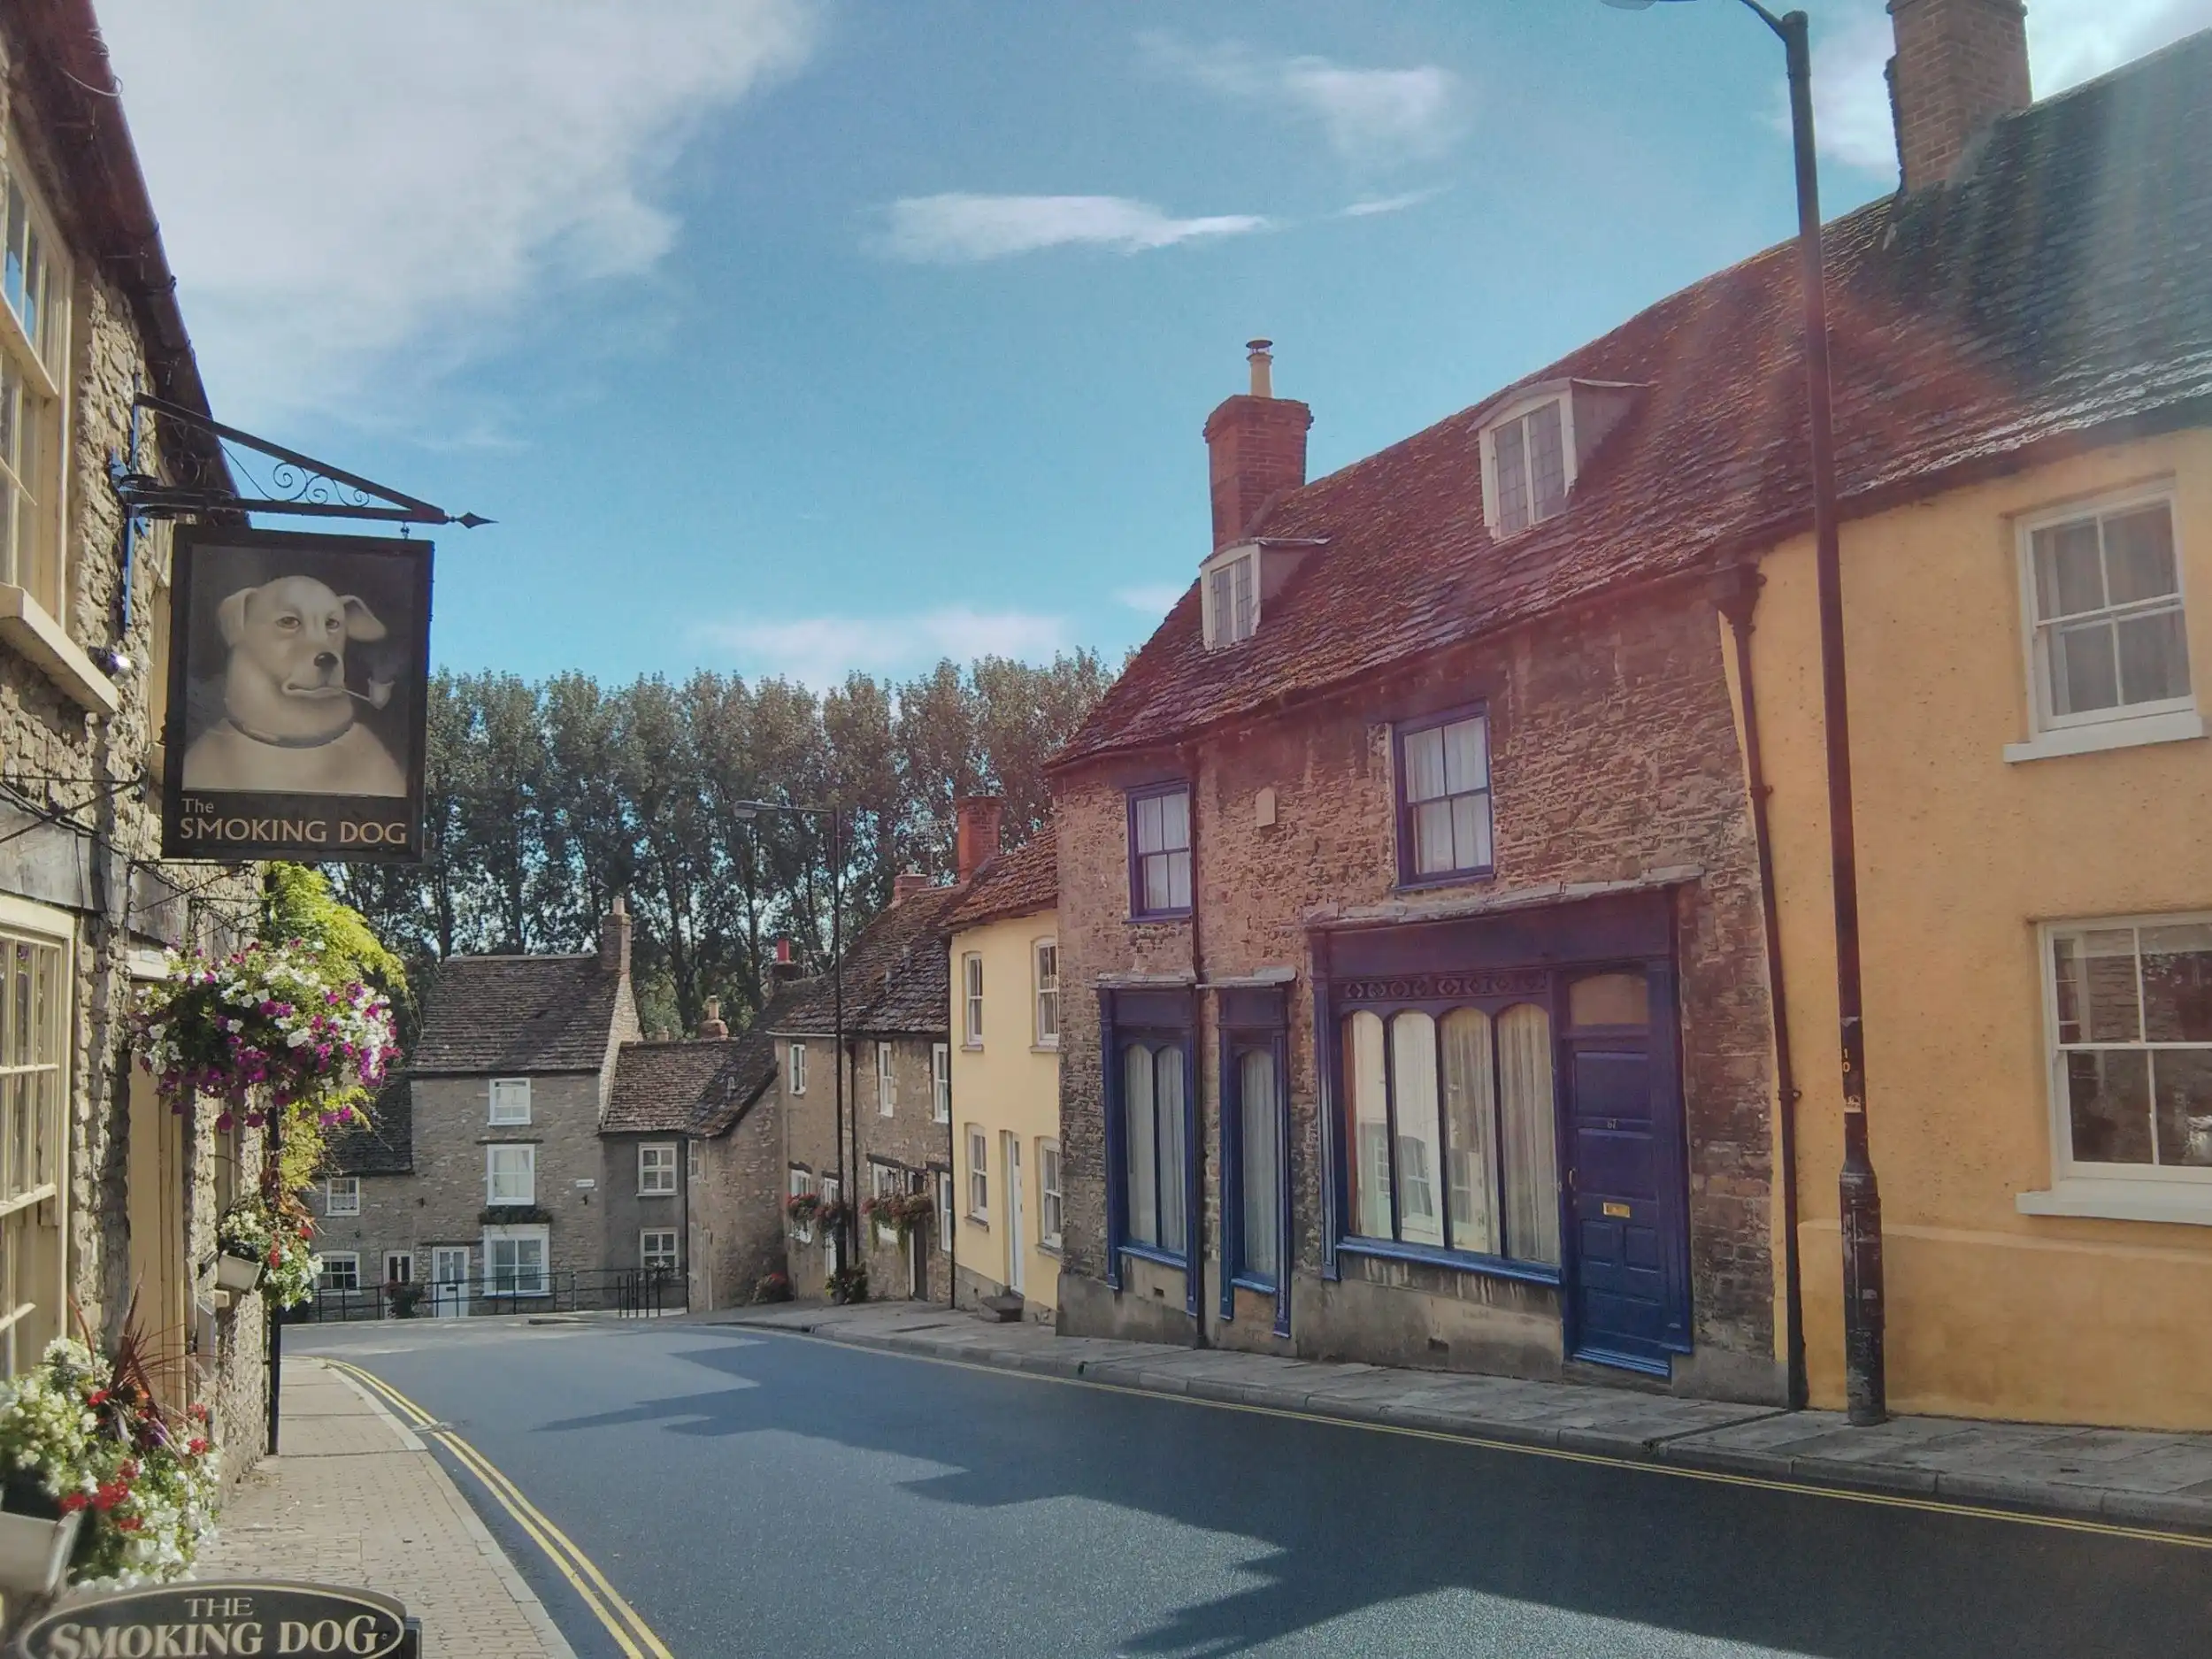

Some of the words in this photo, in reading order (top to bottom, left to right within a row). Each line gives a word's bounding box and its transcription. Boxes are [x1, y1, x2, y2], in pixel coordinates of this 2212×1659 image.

[180, 798, 214, 813] The
[180, 817, 327, 842] SMOKING
[340, 821, 406, 844] DOG
[184, 1597, 253, 1617] THE
[47, 1622, 263, 1659] SMOKING
[277, 1615, 379, 1655] DOG
